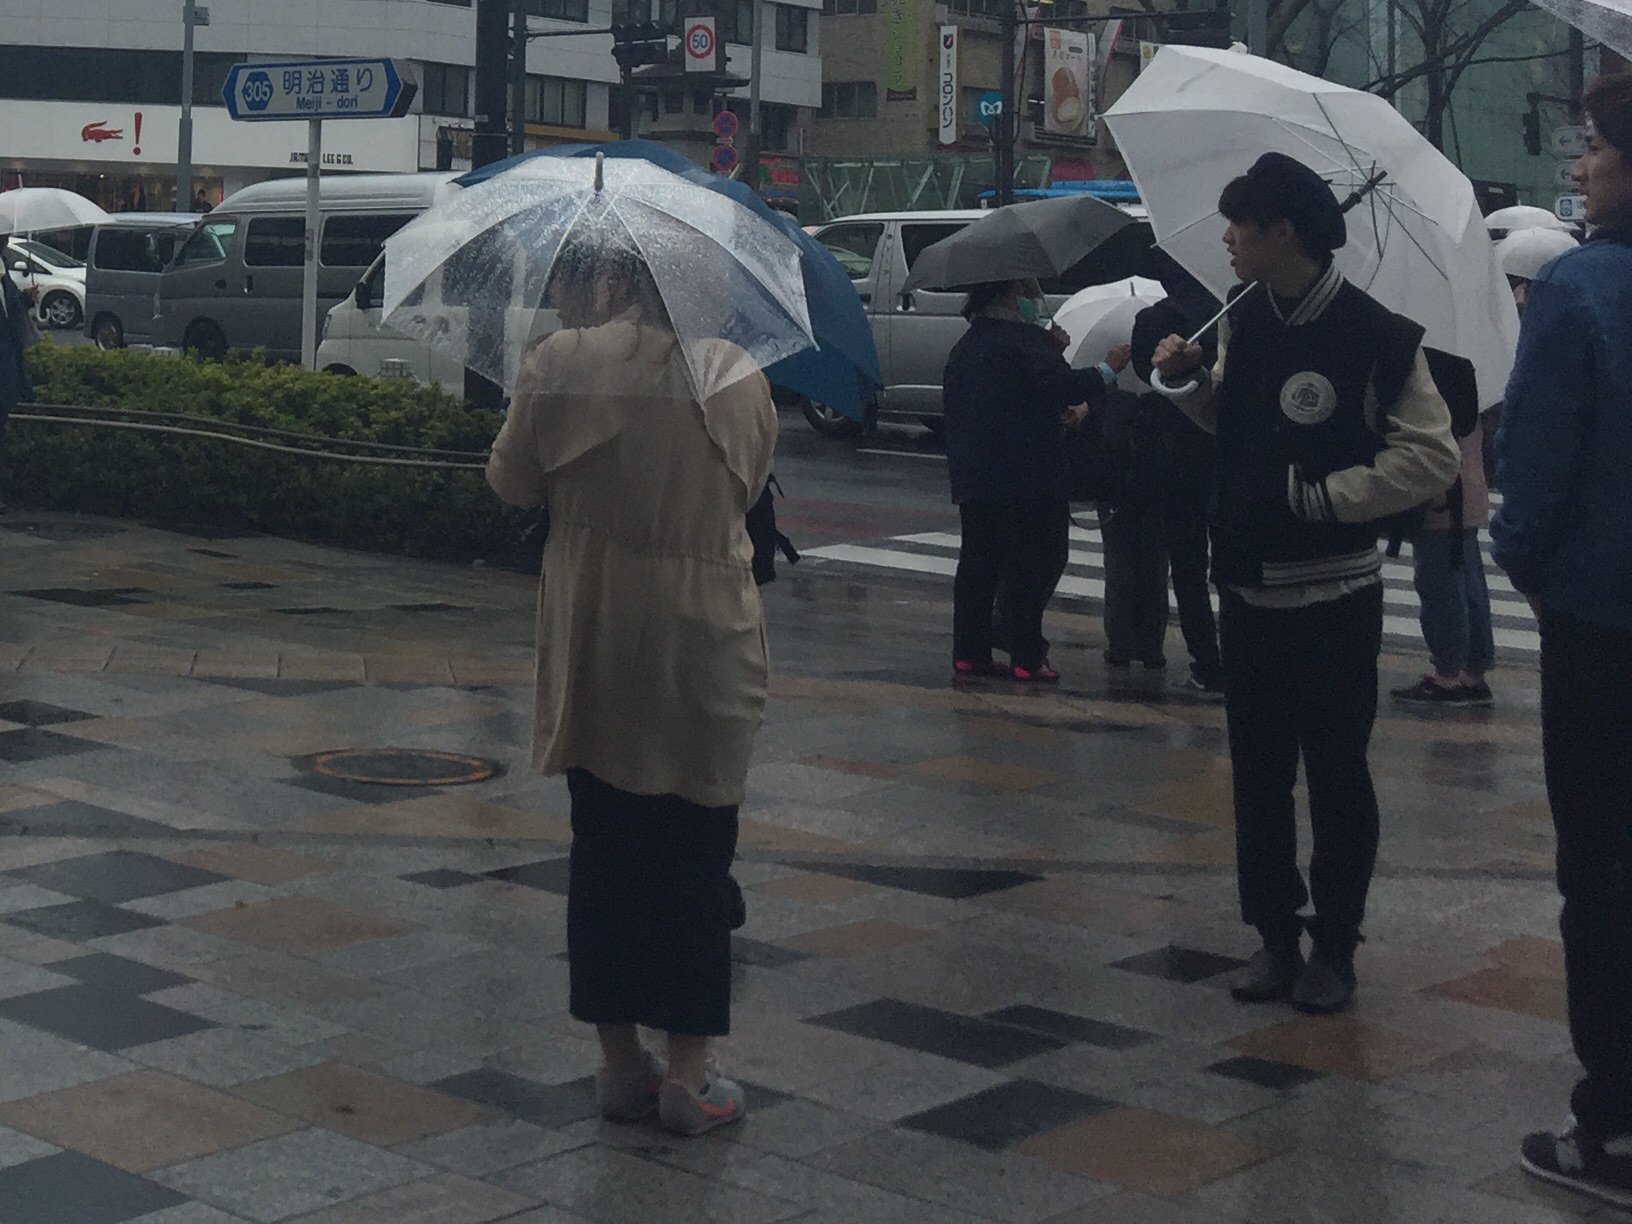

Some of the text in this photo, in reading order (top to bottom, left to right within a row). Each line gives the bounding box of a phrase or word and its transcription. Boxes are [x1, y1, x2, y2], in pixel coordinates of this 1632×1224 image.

[692, 34, 708, 50] 50
[244, 79, 273, 103] 305
[282, 67, 374, 95] 明治通り
[296, 96, 322, 111] Meiji
[336, 93, 358, 109] dori
